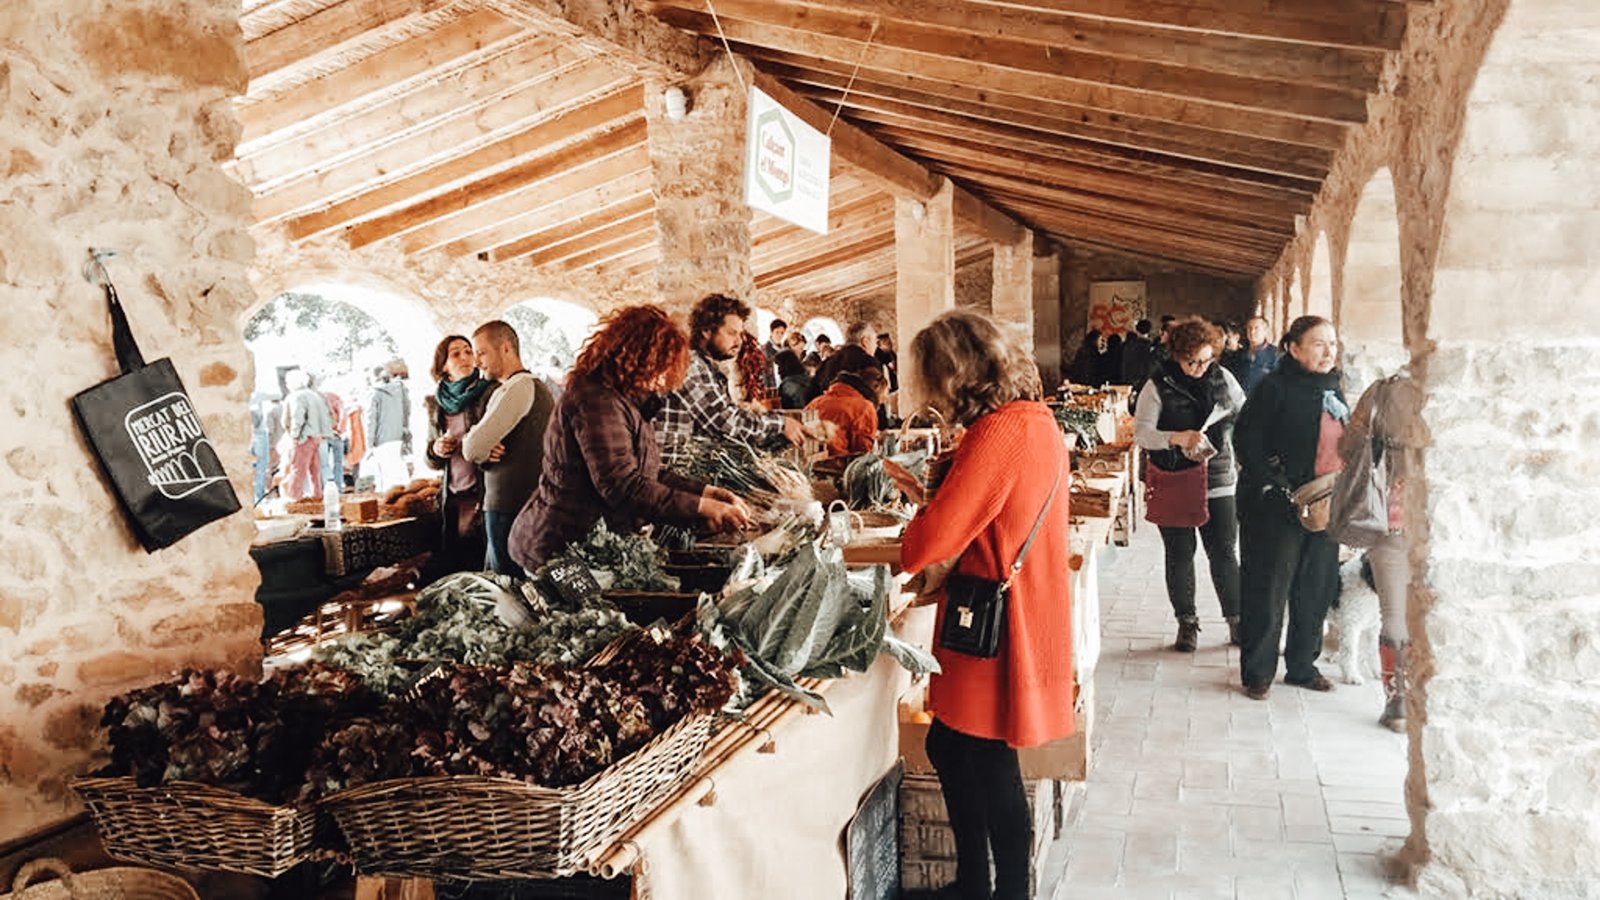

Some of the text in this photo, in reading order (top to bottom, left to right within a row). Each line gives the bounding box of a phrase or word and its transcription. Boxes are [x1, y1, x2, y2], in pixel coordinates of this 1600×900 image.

[130, 399, 191, 435] MERCAT DEL
[137, 413, 201, 458] RIURAU
